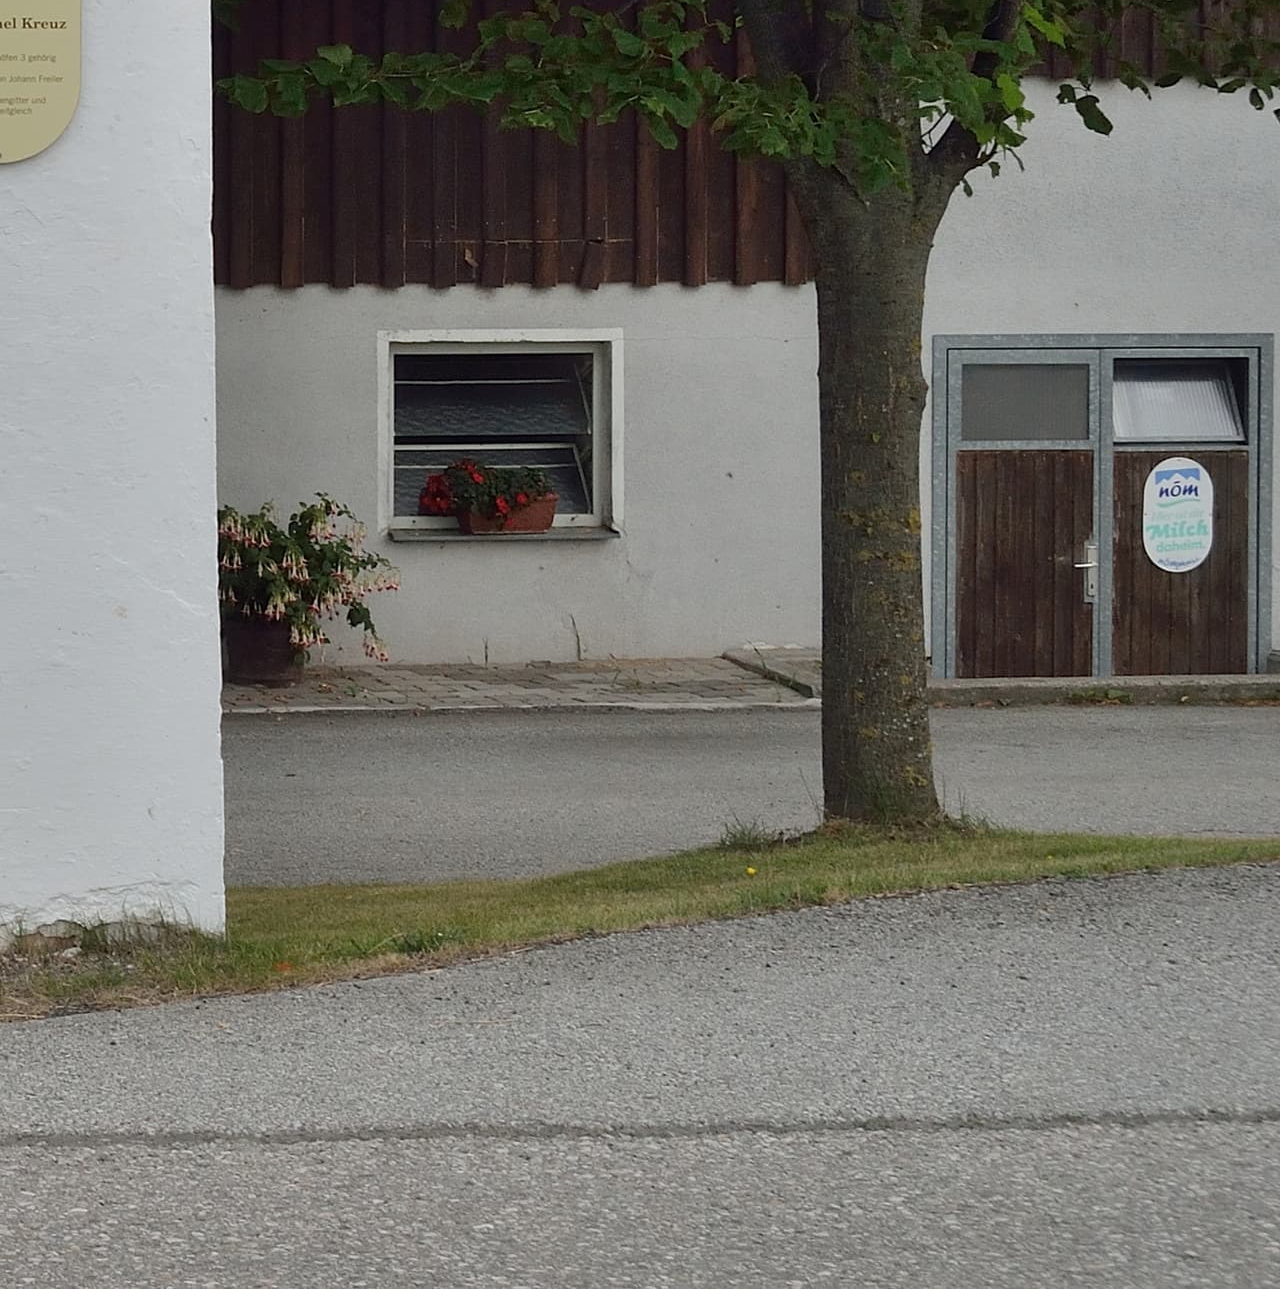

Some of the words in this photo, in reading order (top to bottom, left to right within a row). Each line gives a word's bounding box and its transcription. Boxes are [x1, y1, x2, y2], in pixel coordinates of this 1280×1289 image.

[22, 17, 67, 29] Kreuz
[28, 54, 57, 63] gehörig
[8, 75, 37, 83] Johann
[31, 96, 47, 104] und
[1146, 519, 1208, 539] Milch
